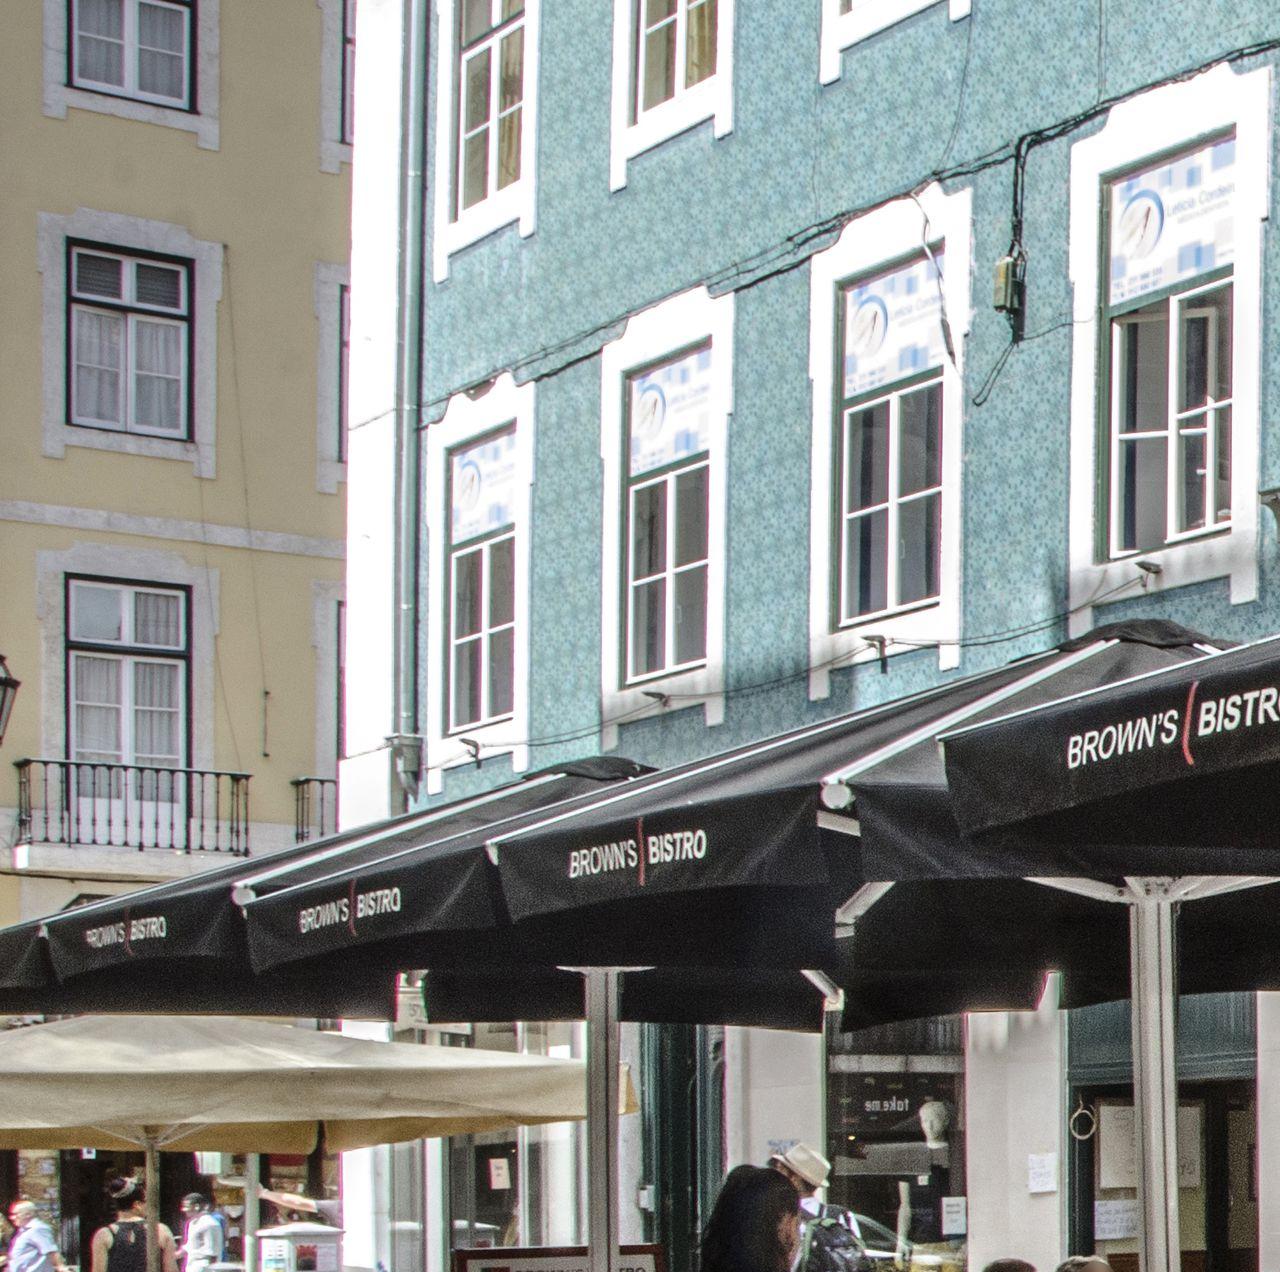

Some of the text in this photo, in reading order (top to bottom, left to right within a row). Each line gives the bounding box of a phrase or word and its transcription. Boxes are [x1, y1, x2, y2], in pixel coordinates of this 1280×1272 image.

[1067, 709, 1179, 770] BROWN'S
[568, 829, 707, 879] BROWN'S BISTRO
[129, 915, 167, 941] BISTRO
[299, 887, 402, 934] BROWN'S BISTRO
